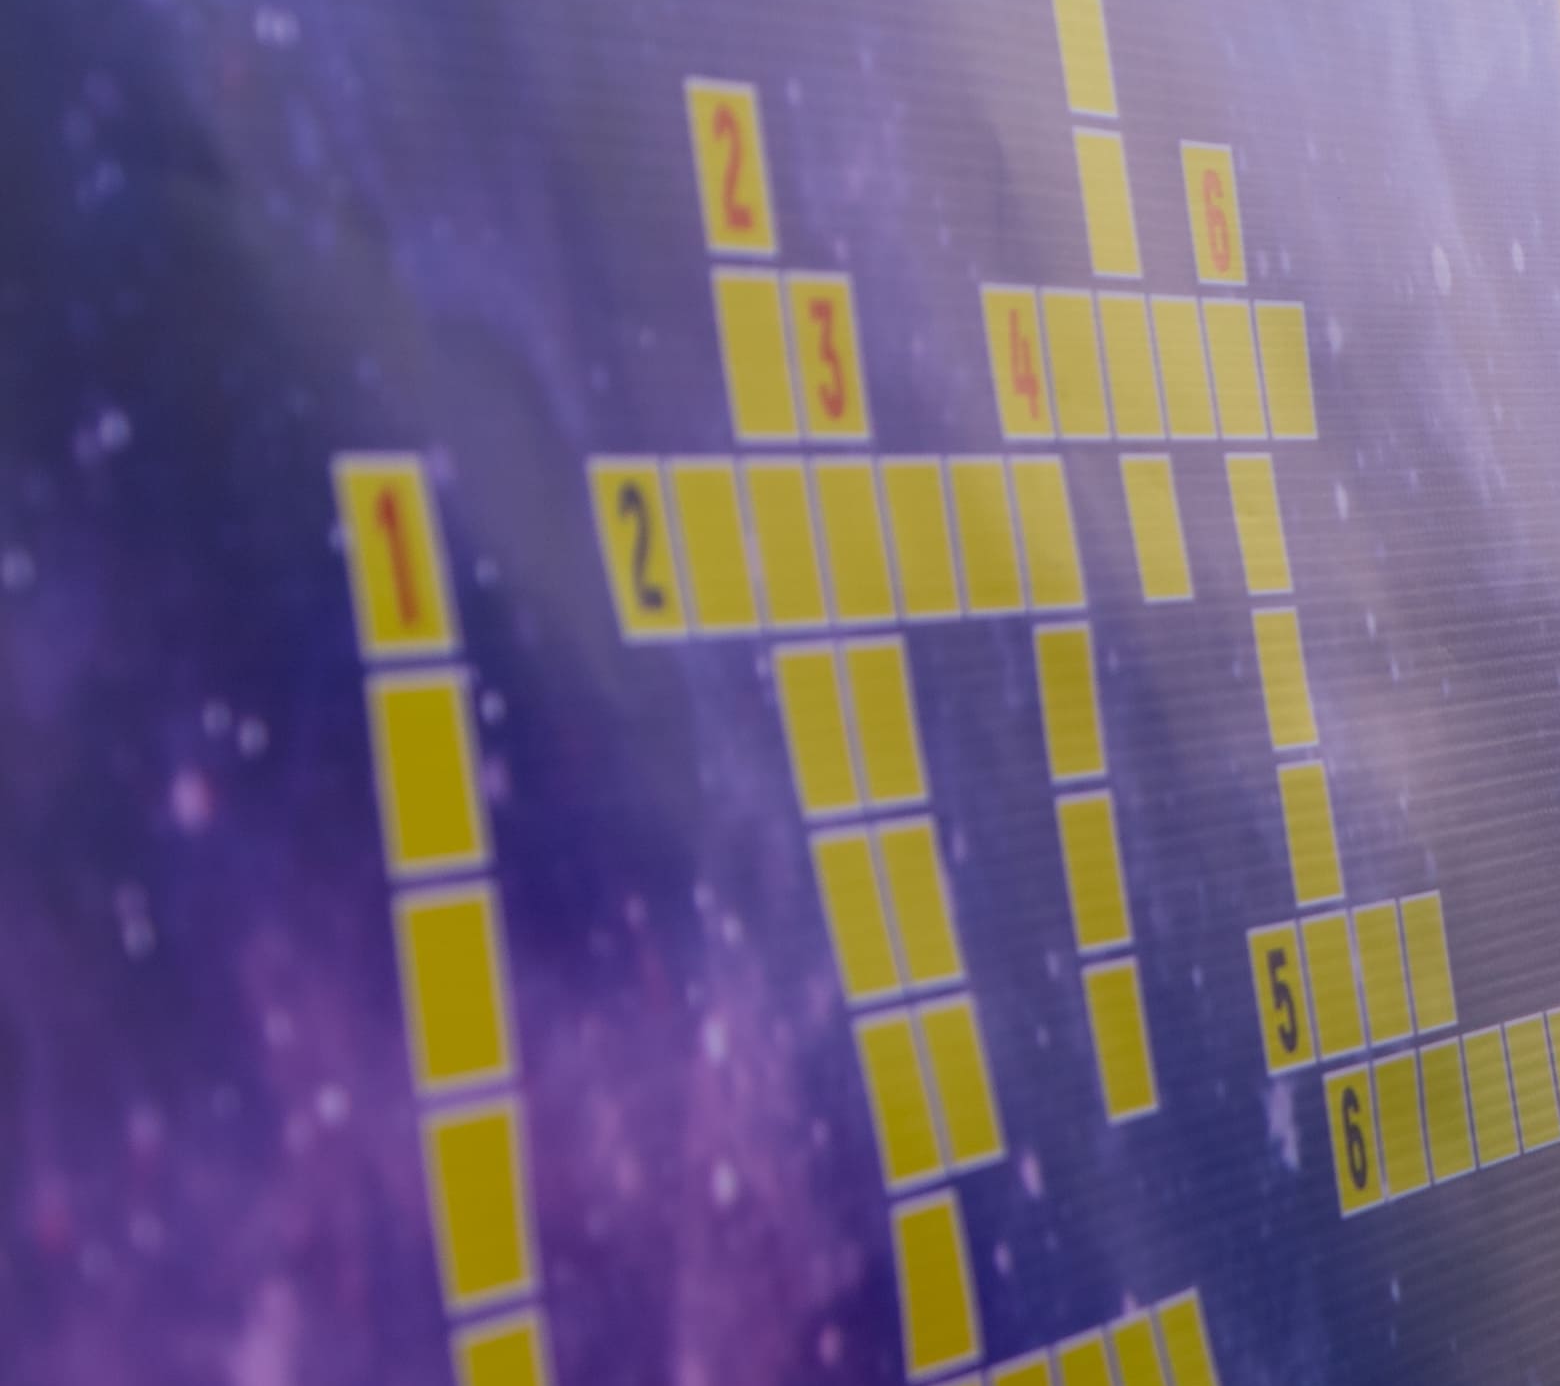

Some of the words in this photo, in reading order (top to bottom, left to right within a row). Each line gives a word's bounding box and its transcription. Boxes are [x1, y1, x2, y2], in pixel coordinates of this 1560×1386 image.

[713, 103, 754, 233] 2
[1203, 169, 1230, 274] 6
[809, 297, 845, 420] 3
[1009, 310, 1040, 421] 4
[375, 486, 421, 630] 1
[617, 480, 668, 611] 2
[1266, 947, 1297, 1053] 5
[1341, 1087, 1368, 1190] 6
